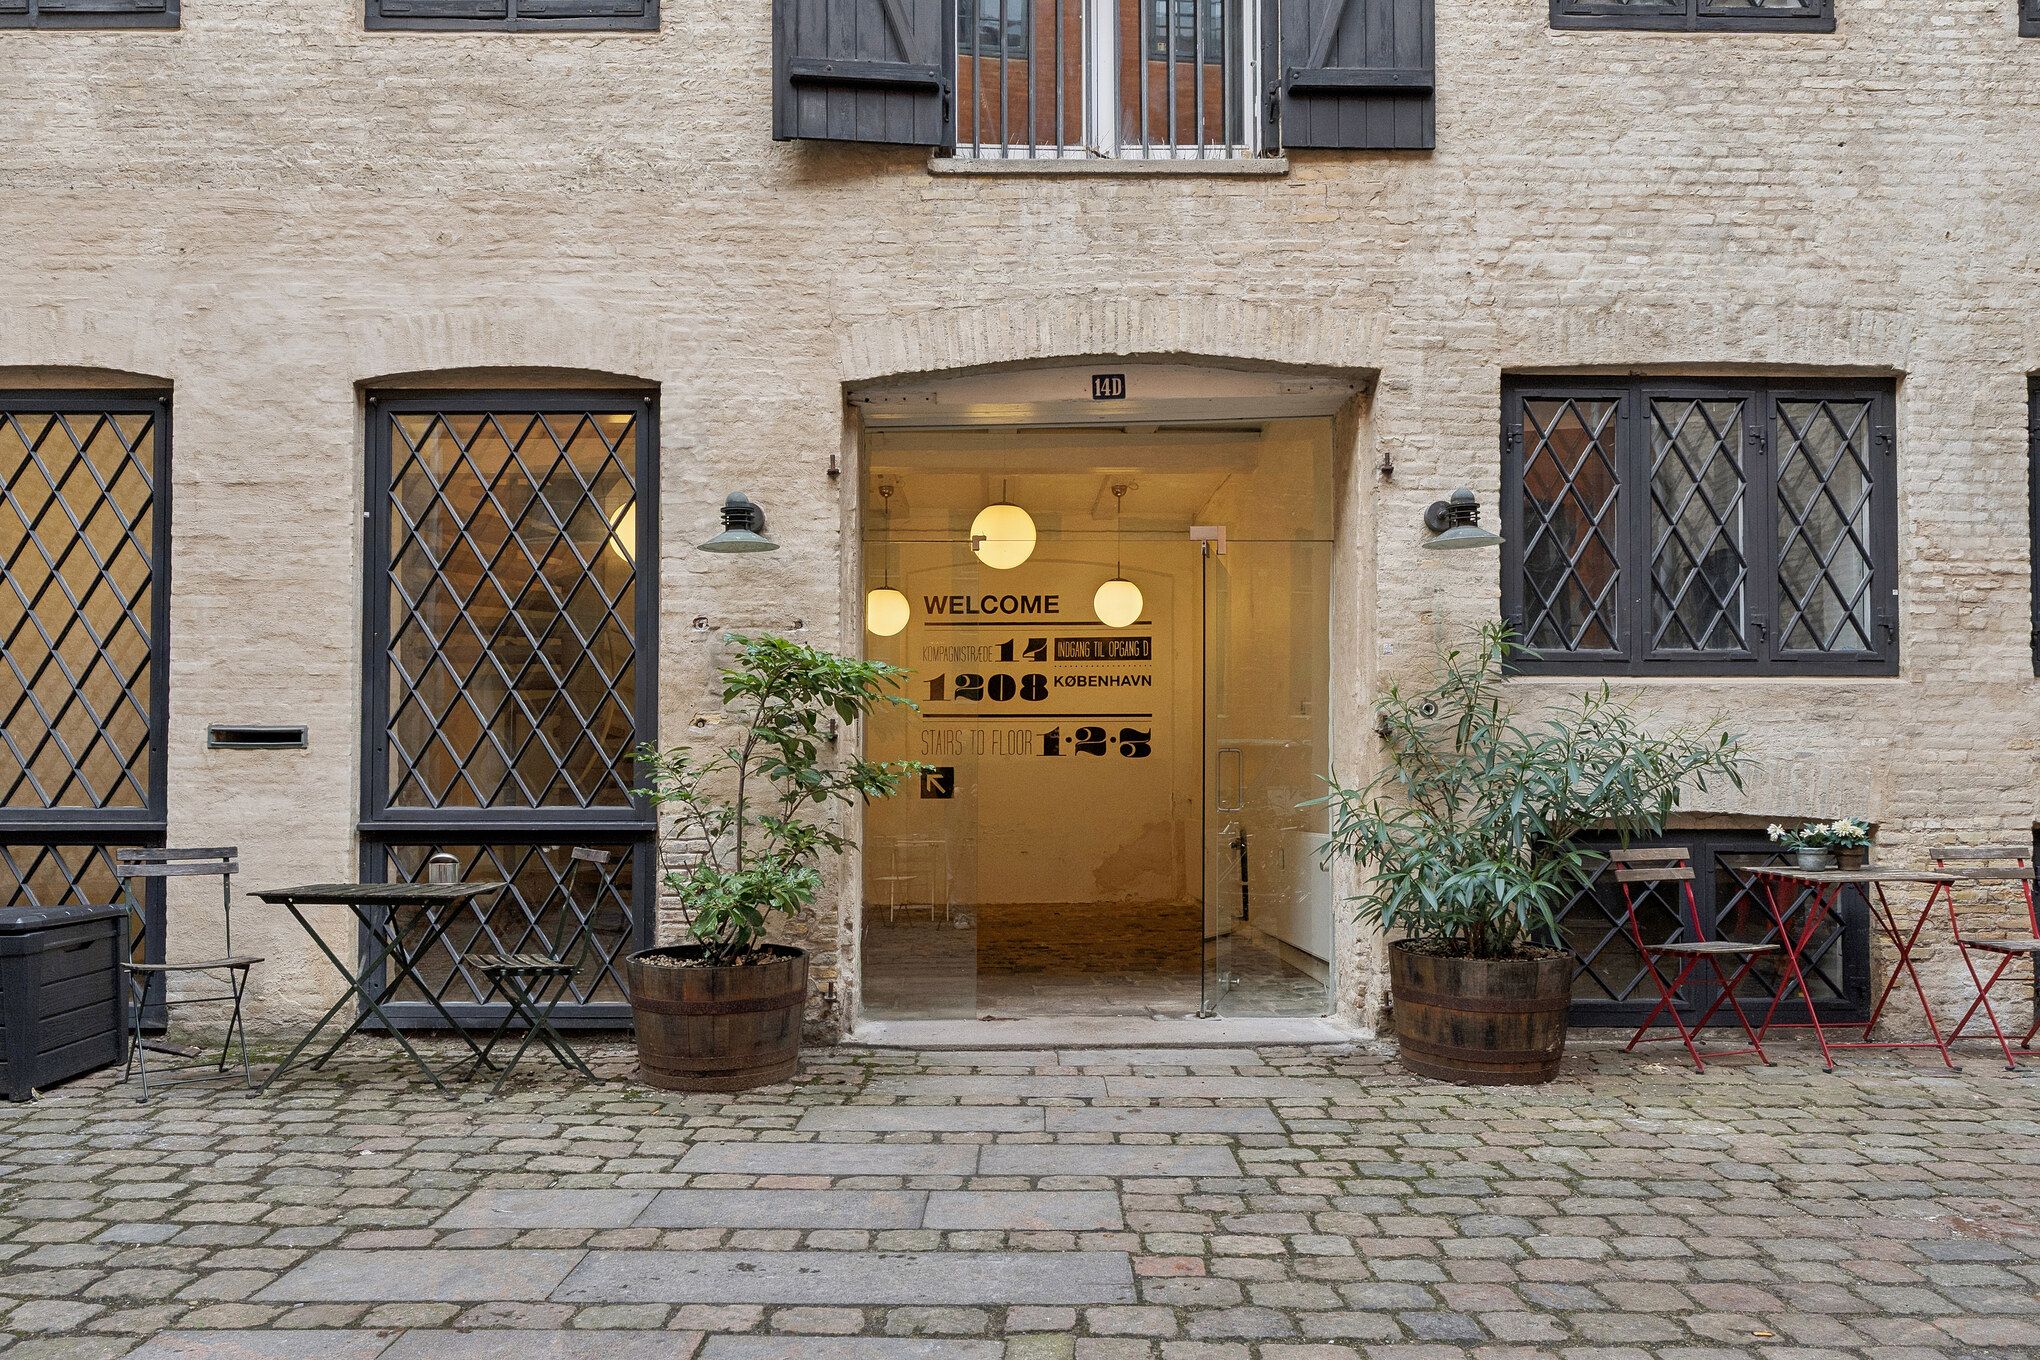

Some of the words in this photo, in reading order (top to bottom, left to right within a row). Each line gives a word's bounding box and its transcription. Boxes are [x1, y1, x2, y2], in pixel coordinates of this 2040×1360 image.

[1094, 377, 1122, 397] 14D
[923, 594, 1060, 615] WELCOME
[994, 637, 1048, 663] 14
[1057, 641, 1090, 658] INDGANG
[1093, 641, 1105, 657] TIL
[1108, 641, 1140, 657] OPGANG
[1143, 640, 1149, 657] D
[922, 672, 1049, 702] 1208
[1053, 674, 1152, 688] KØBENHAVN
[921, 729, 963, 756] STAIRS
[970, 729, 985, 756] TO
[991, 729, 1033, 756] FLOOR
